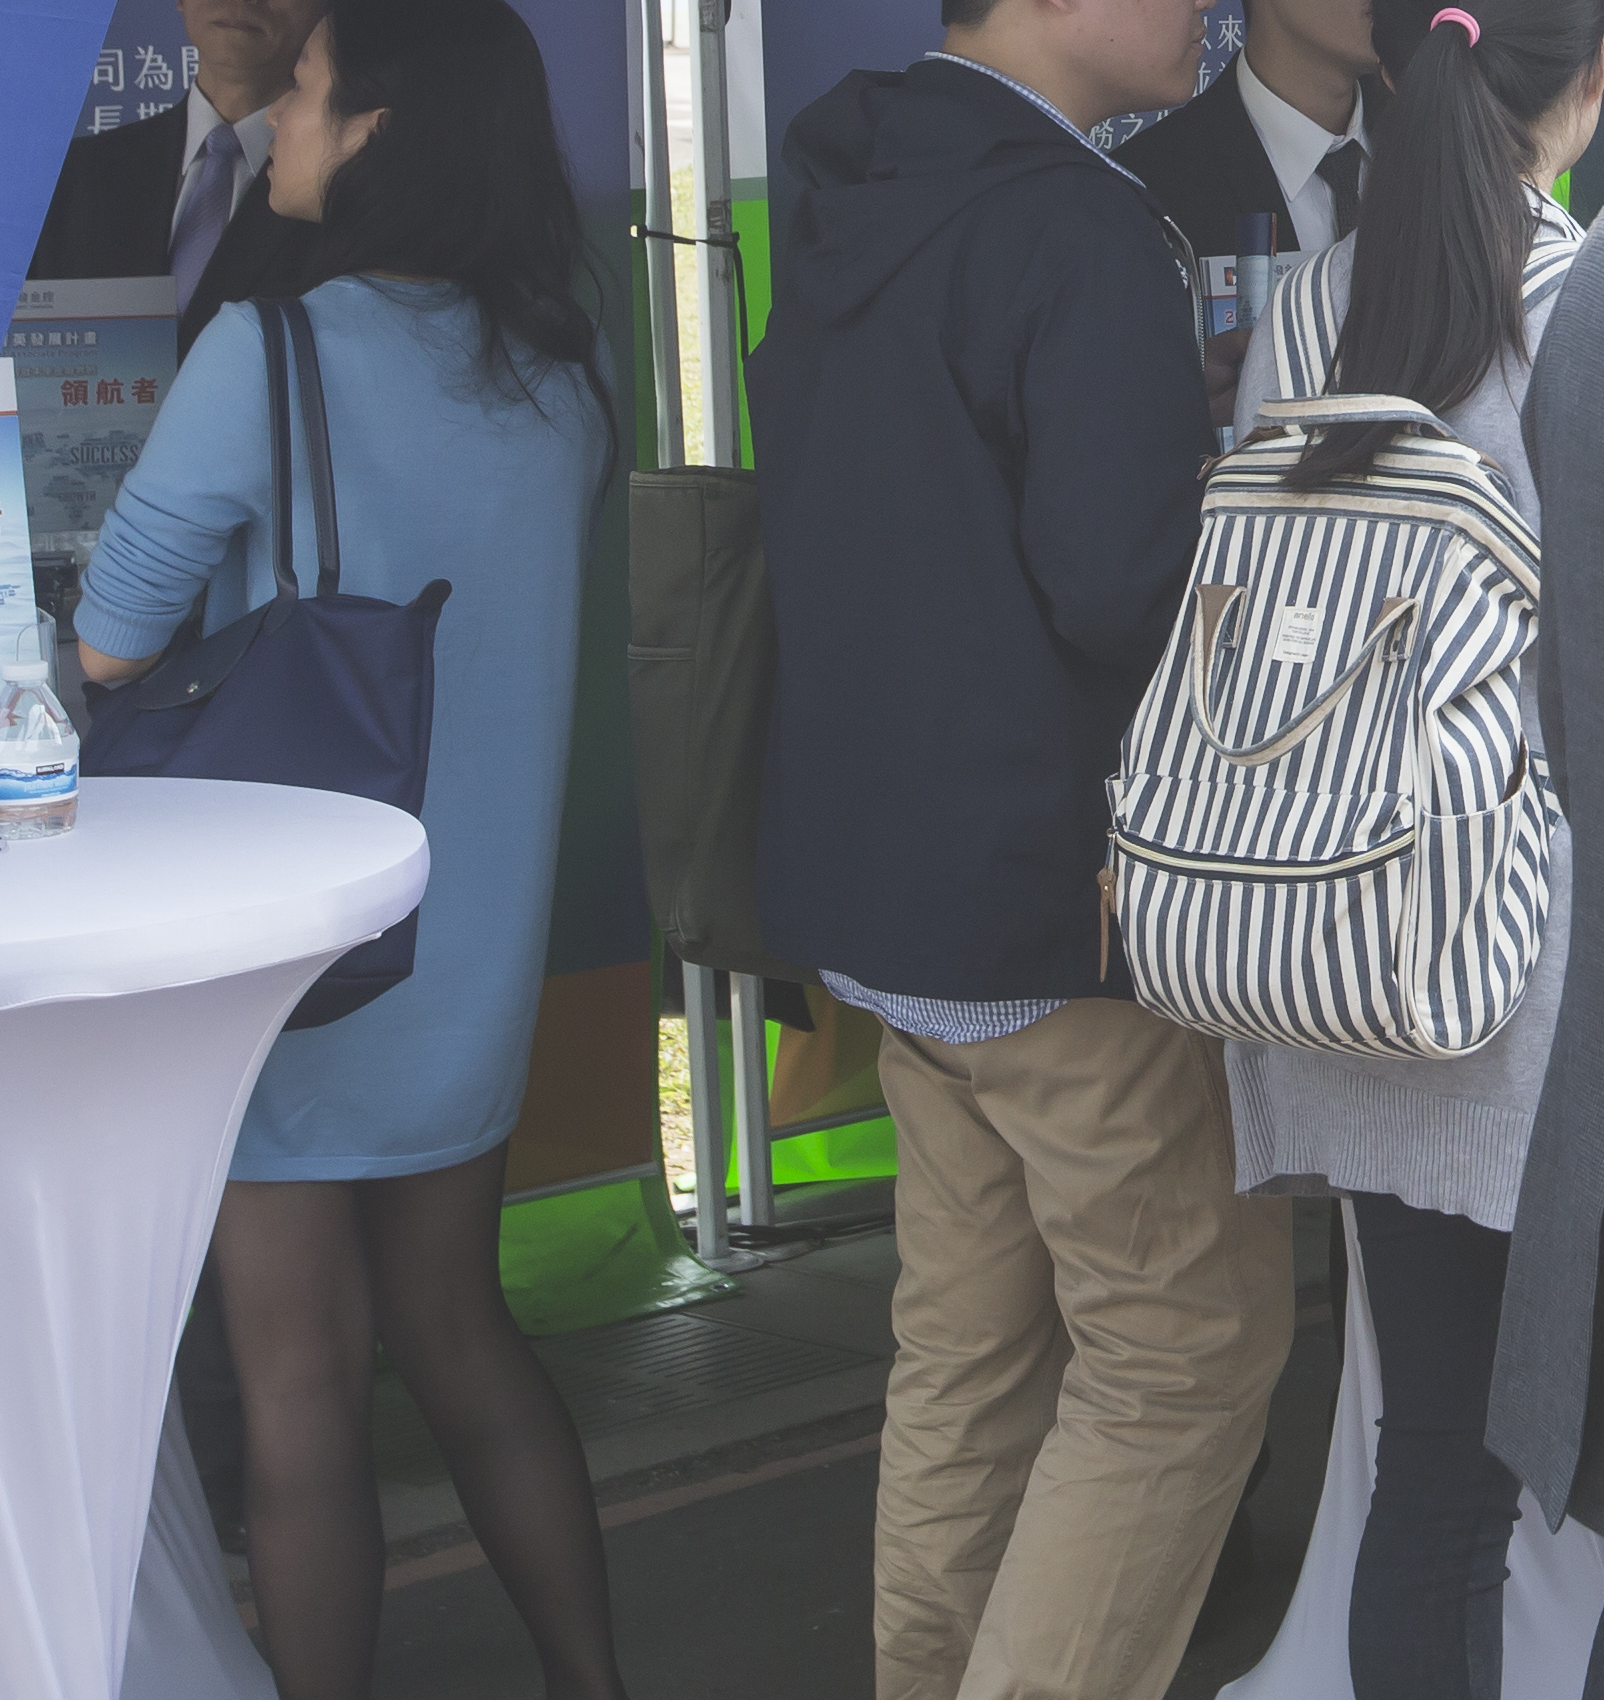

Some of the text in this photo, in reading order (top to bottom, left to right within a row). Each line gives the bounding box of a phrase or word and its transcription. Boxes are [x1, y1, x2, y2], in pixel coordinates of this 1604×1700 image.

[60, 377, 159, 407] 領航者
[70, 443, 138, 465] SUCCESS
